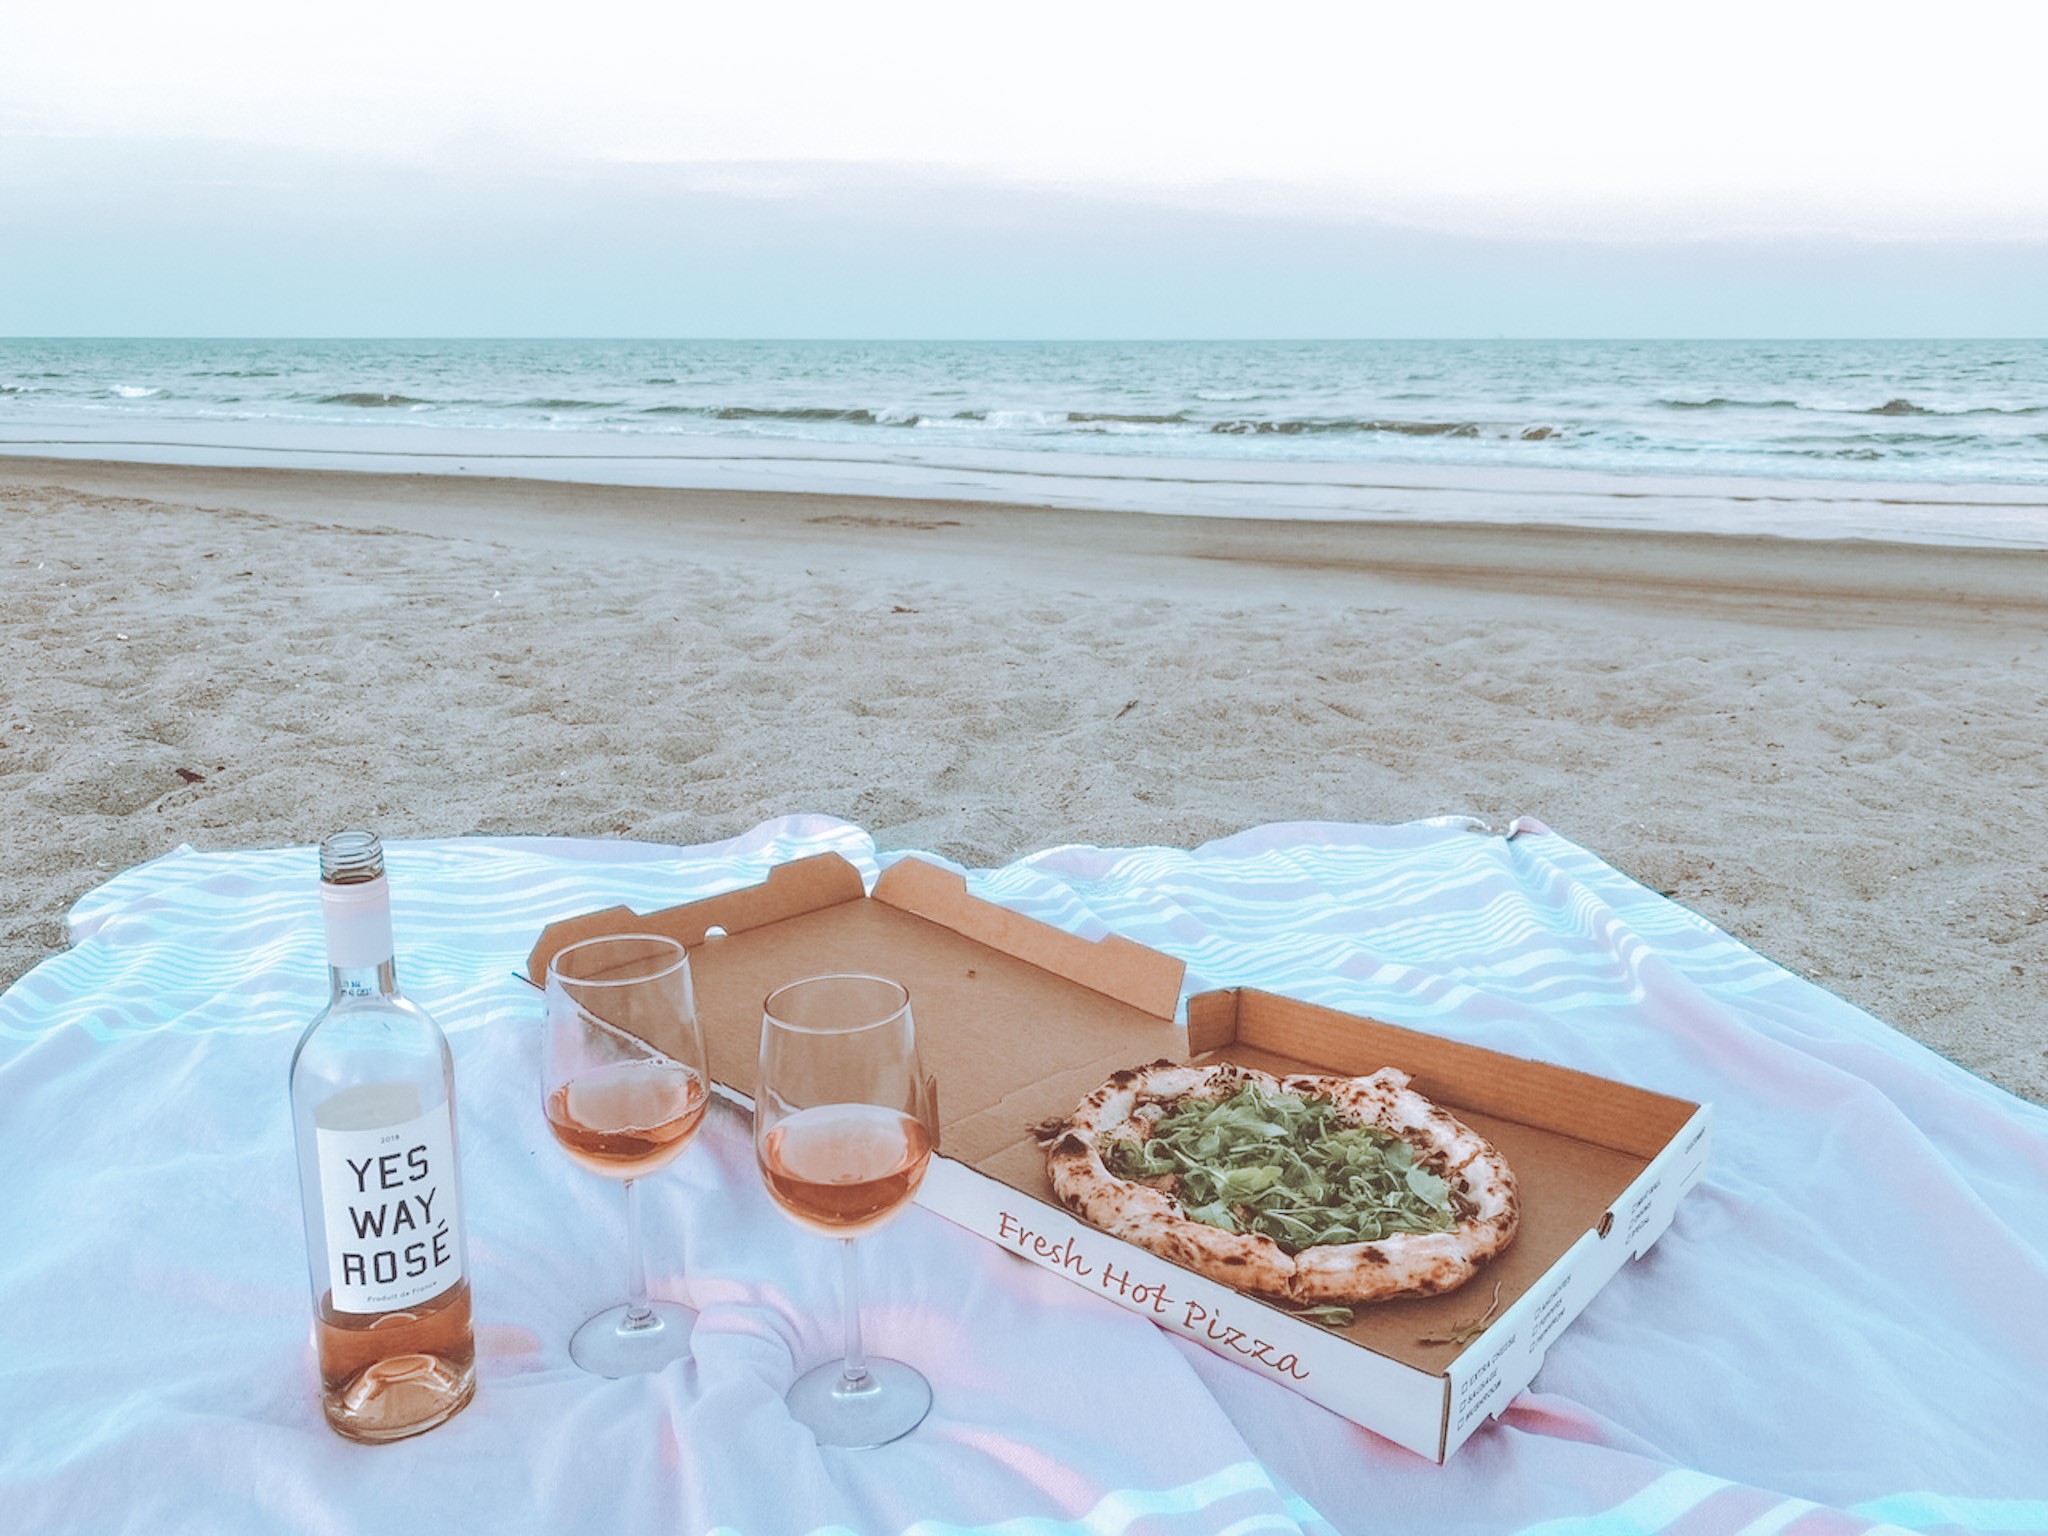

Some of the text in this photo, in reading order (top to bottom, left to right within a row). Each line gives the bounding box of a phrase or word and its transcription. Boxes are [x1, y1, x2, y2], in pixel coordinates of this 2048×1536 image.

[346, 1145, 429, 1193] YES
[348, 1187, 437, 1239] WAY
[342, 1218, 451, 1286] ROSÉ
[367, 1281, 438, 1302] Produit de France
[998, 1212, 1310, 1380] Fresh Hot Pizza
